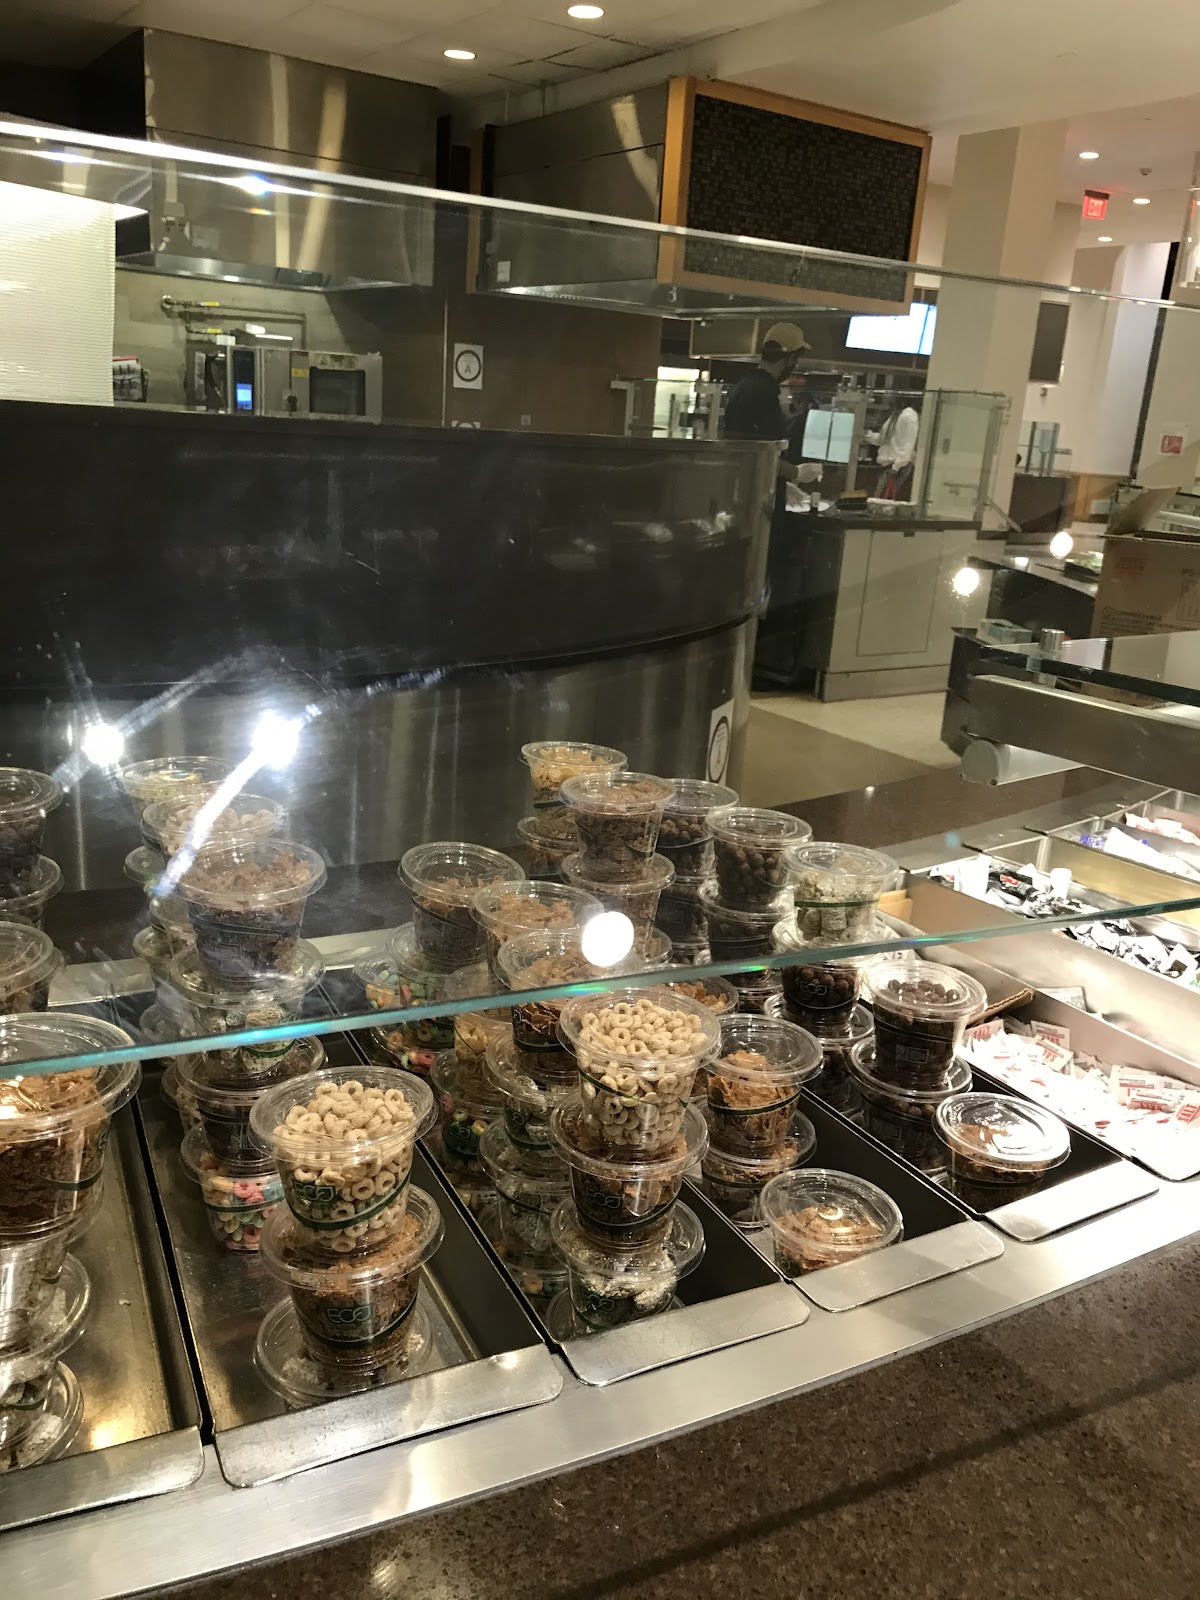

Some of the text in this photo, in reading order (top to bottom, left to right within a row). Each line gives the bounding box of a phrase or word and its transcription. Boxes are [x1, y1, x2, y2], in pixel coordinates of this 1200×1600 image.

[1177, 1103, 1198, 1122] SALT
[292, 1179, 337, 1202] ECO
[585, 1186, 622, 1210] ECO
[326, 1304, 372, 1324] ECO
